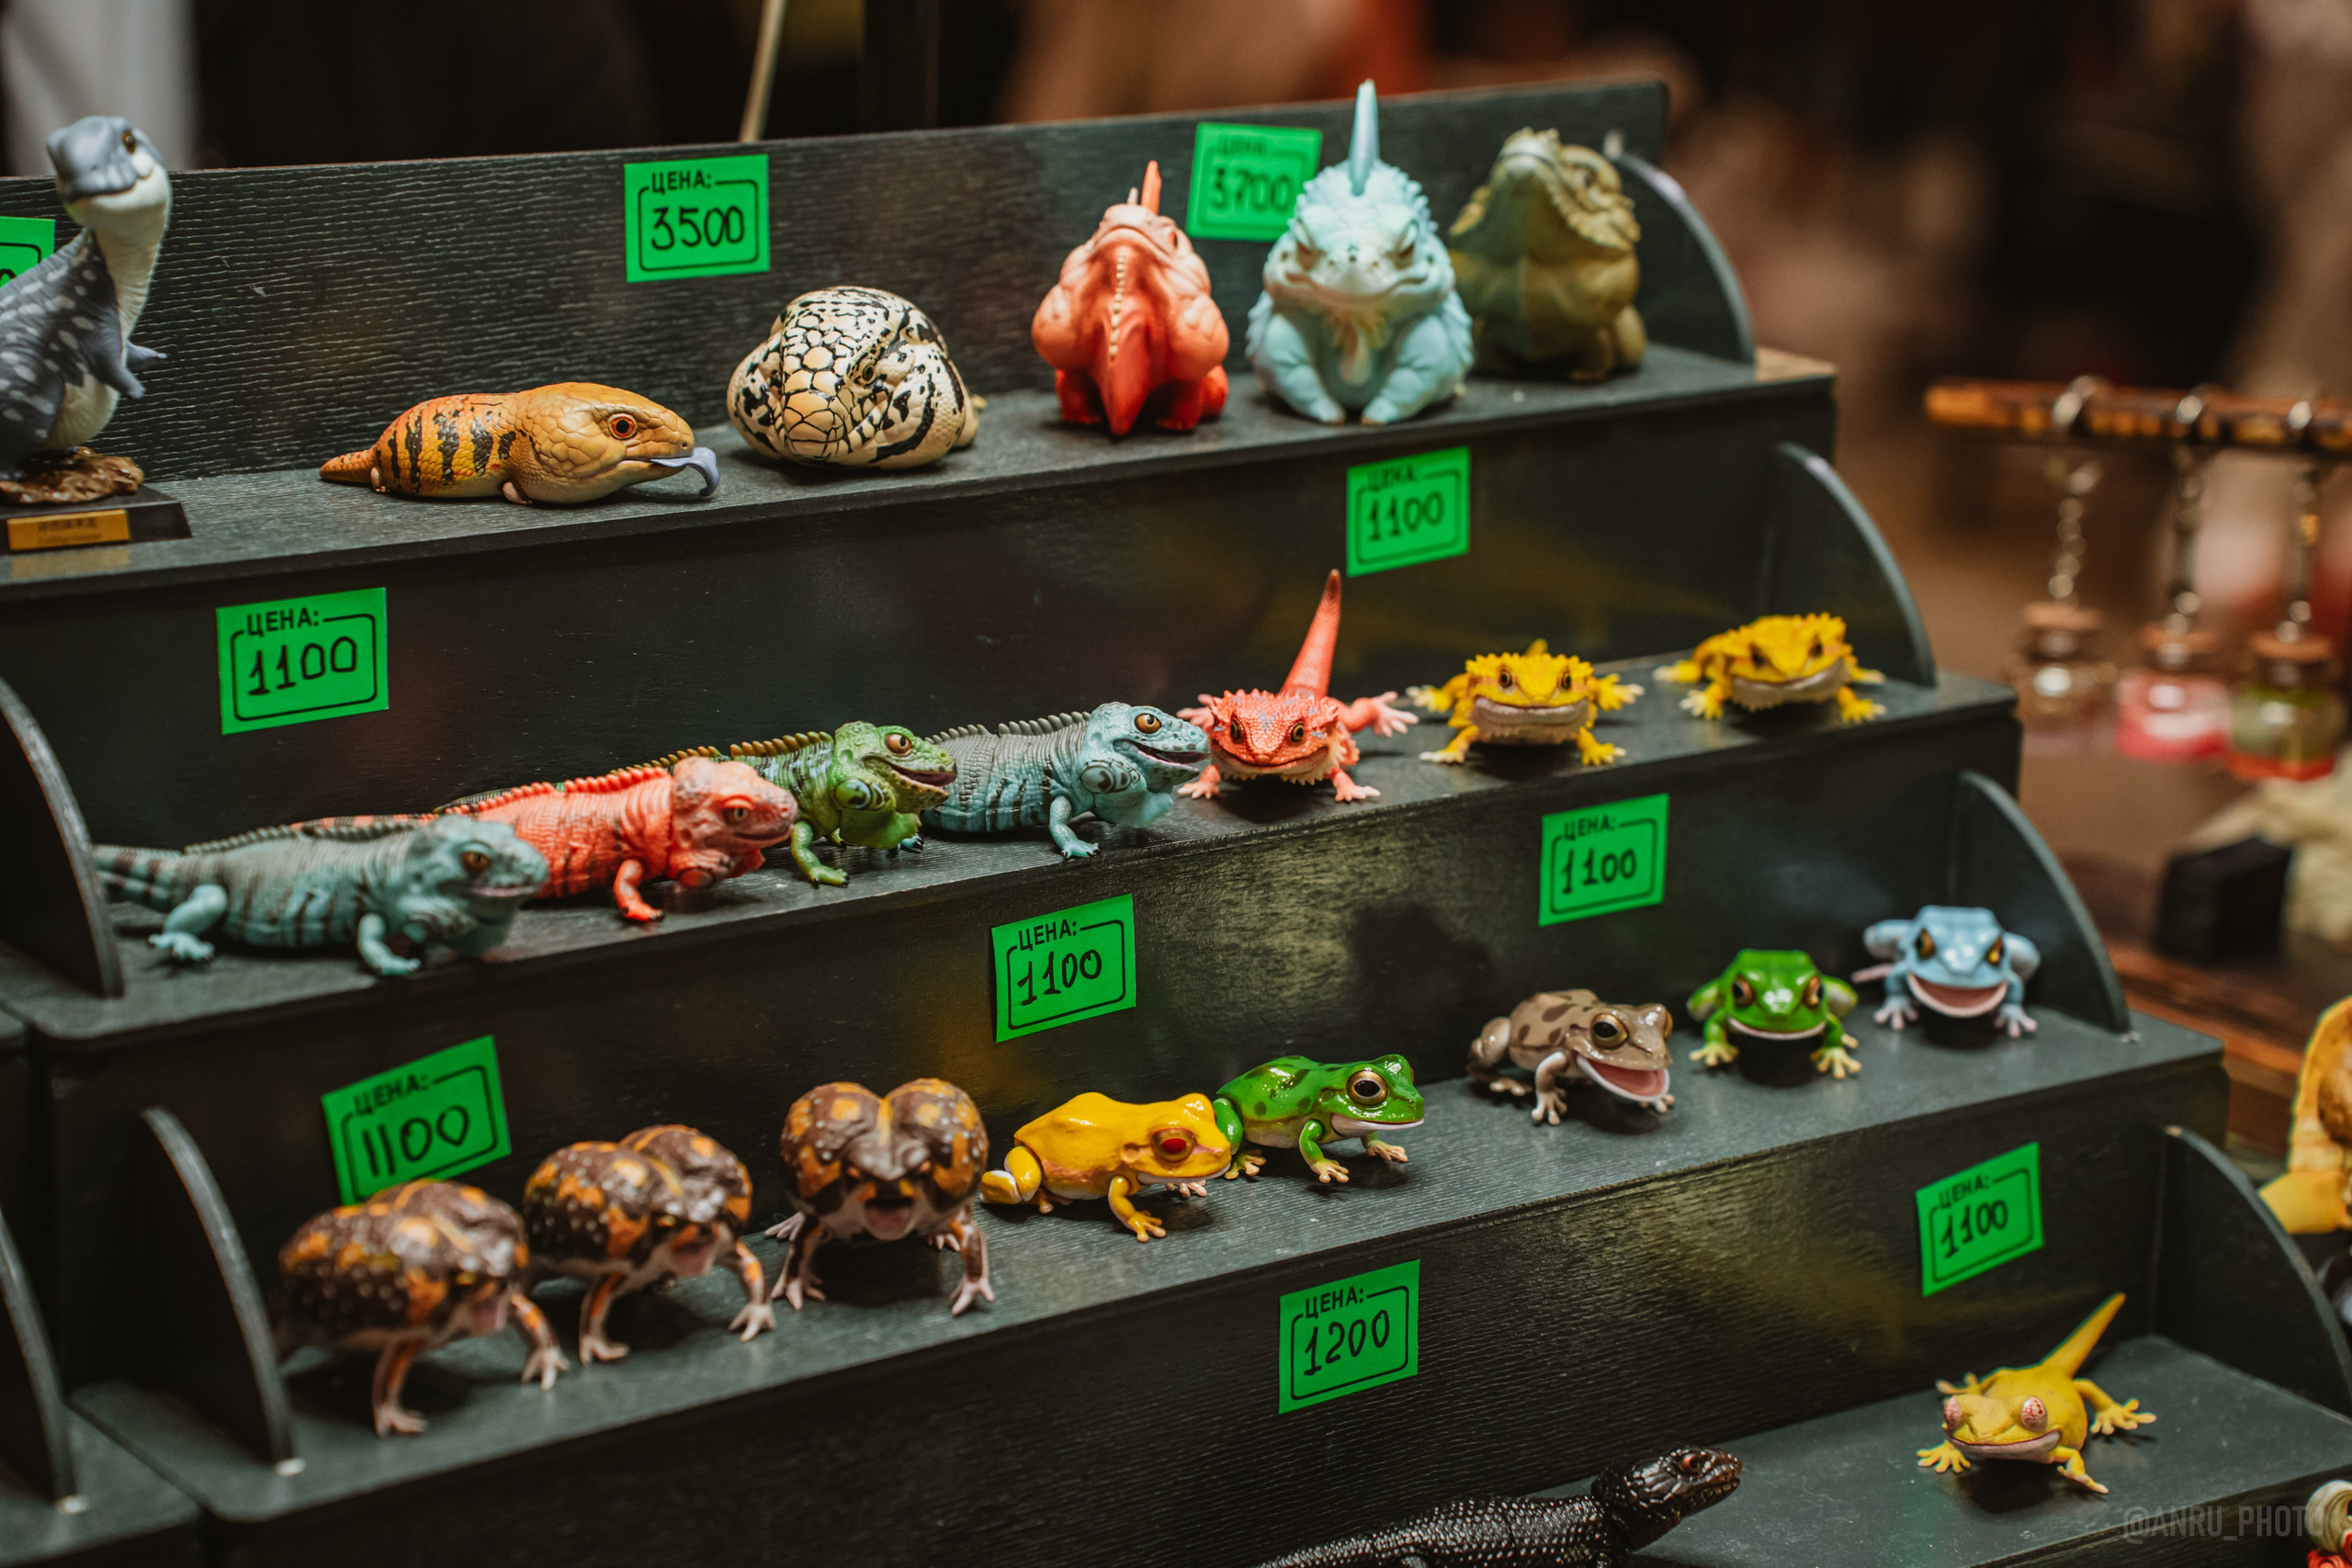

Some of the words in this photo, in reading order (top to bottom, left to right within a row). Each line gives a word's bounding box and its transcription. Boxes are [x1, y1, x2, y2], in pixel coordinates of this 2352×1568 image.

[651, 169, 711, 195] ЦЕНА:
[651, 205, 745, 250] 3500
[1366, 491, 1445, 541] 1100
[247, 607, 319, 637] ЦЕНА:
[247, 636, 357, 695] 1100
[1564, 814, 1617, 841] ЦЕНА:
[1561, 848, 1636, 895] 1100
[1018, 919, 1077, 952] ЦЕНА:
[1017, 949, 1102, 1006] 1100
[354, 1073, 429, 1116] ЦЕНА:
[362, 1105, 469, 1179] 1100
[1939, 1174, 1989, 1209] ЦЕНА:
[1941, 1200, 2008, 1258] 1100
[1306, 1286, 1363, 1319] ЦЕНА:
[1304, 1309, 1390, 1376] 1200
